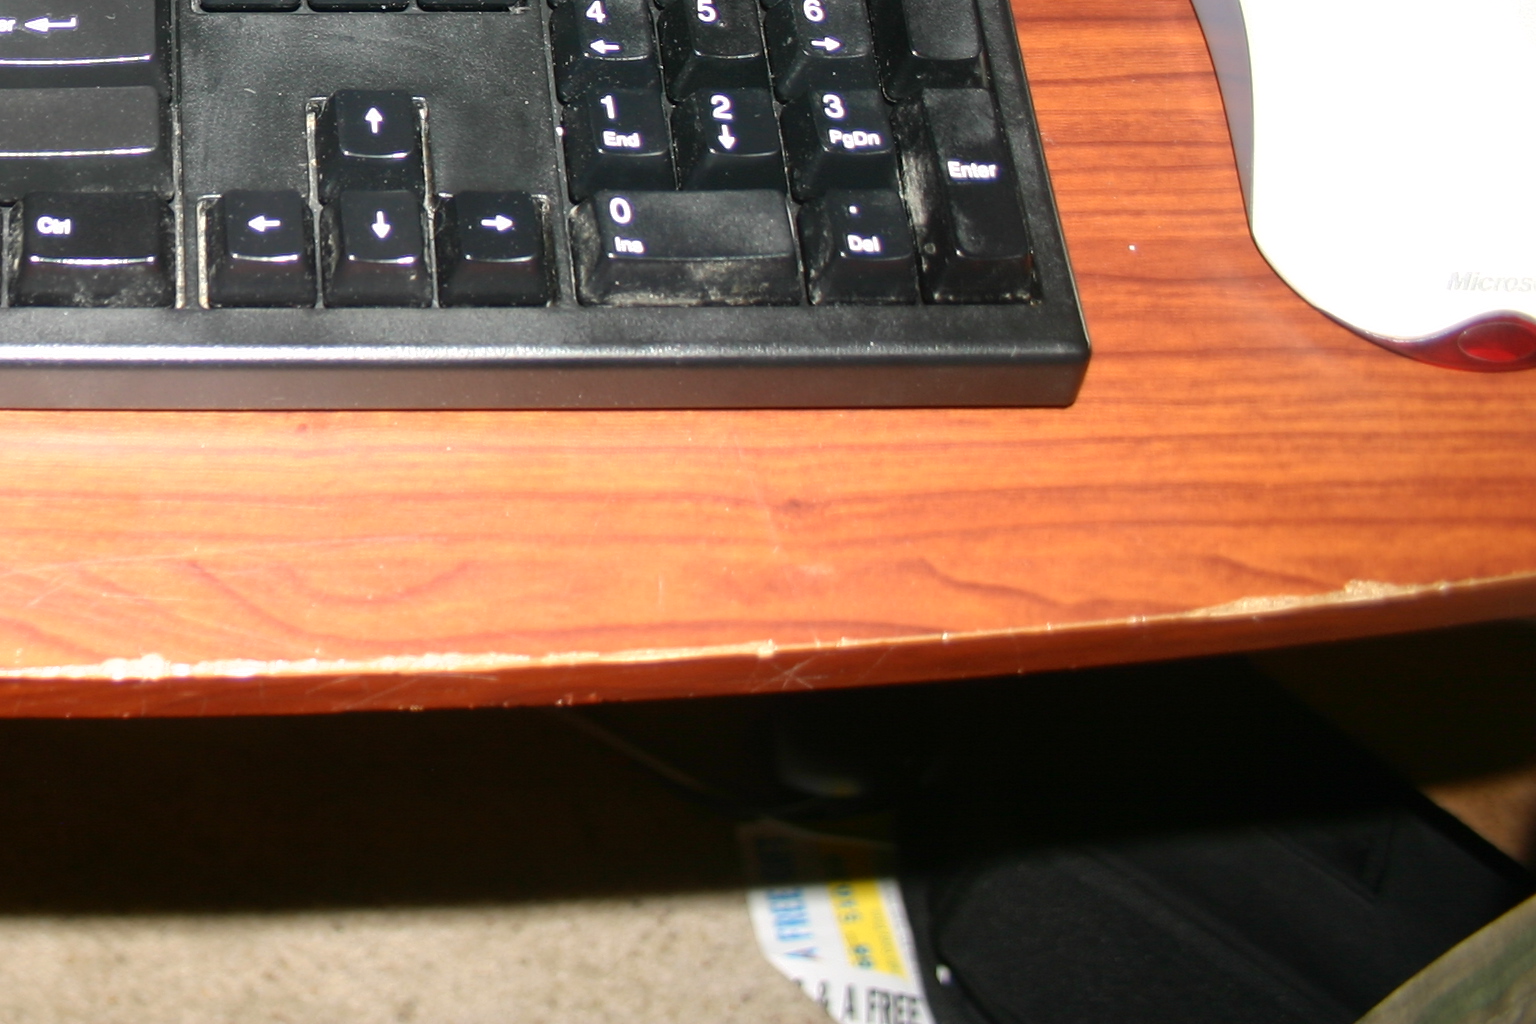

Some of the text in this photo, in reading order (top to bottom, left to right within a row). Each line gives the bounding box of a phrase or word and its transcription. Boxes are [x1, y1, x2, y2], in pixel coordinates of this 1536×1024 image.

[585, 0, 607, 24] 4
[600, 94, 616, 120] 1
[710, 94, 734, 121] 2
[822, 93, 845, 119] 3
[602, 130, 642, 149] End
[828, 128, 882, 150] PgDn
[946, 160, 998, 180] Enter
[609, 196, 633, 225] 0
[36, 215, 72, 235] Ctrl
[613, 235, 645, 255] Ins
[846, 234, 881, 253] Del
[1447, 271, 1536, 292] Micros
